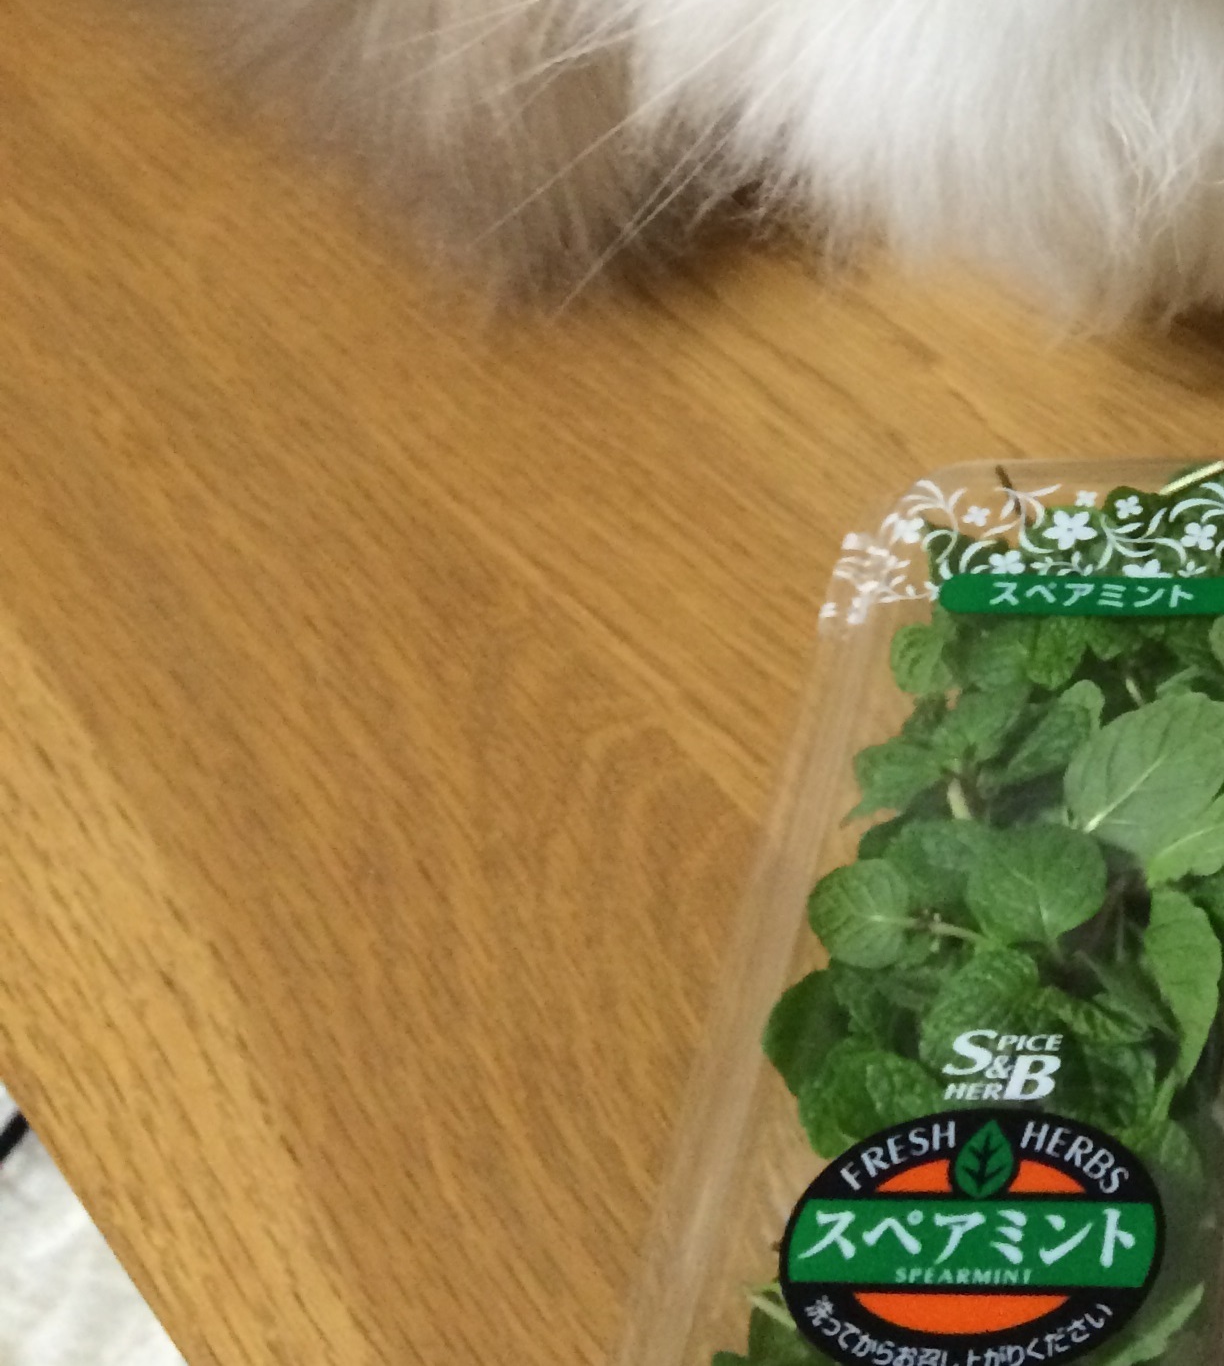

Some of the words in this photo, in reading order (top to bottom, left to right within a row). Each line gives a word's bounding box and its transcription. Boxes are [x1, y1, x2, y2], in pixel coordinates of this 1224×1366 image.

[989, 581, 1194, 608] スペアミント
[840, 1121, 957, 1191] FRESH
[1020, 1121, 1129, 1195] HERBS
[798, 1208, 1136, 1268] スペアミント
[895, 1267, 1034, 1285] SPEARMINT
